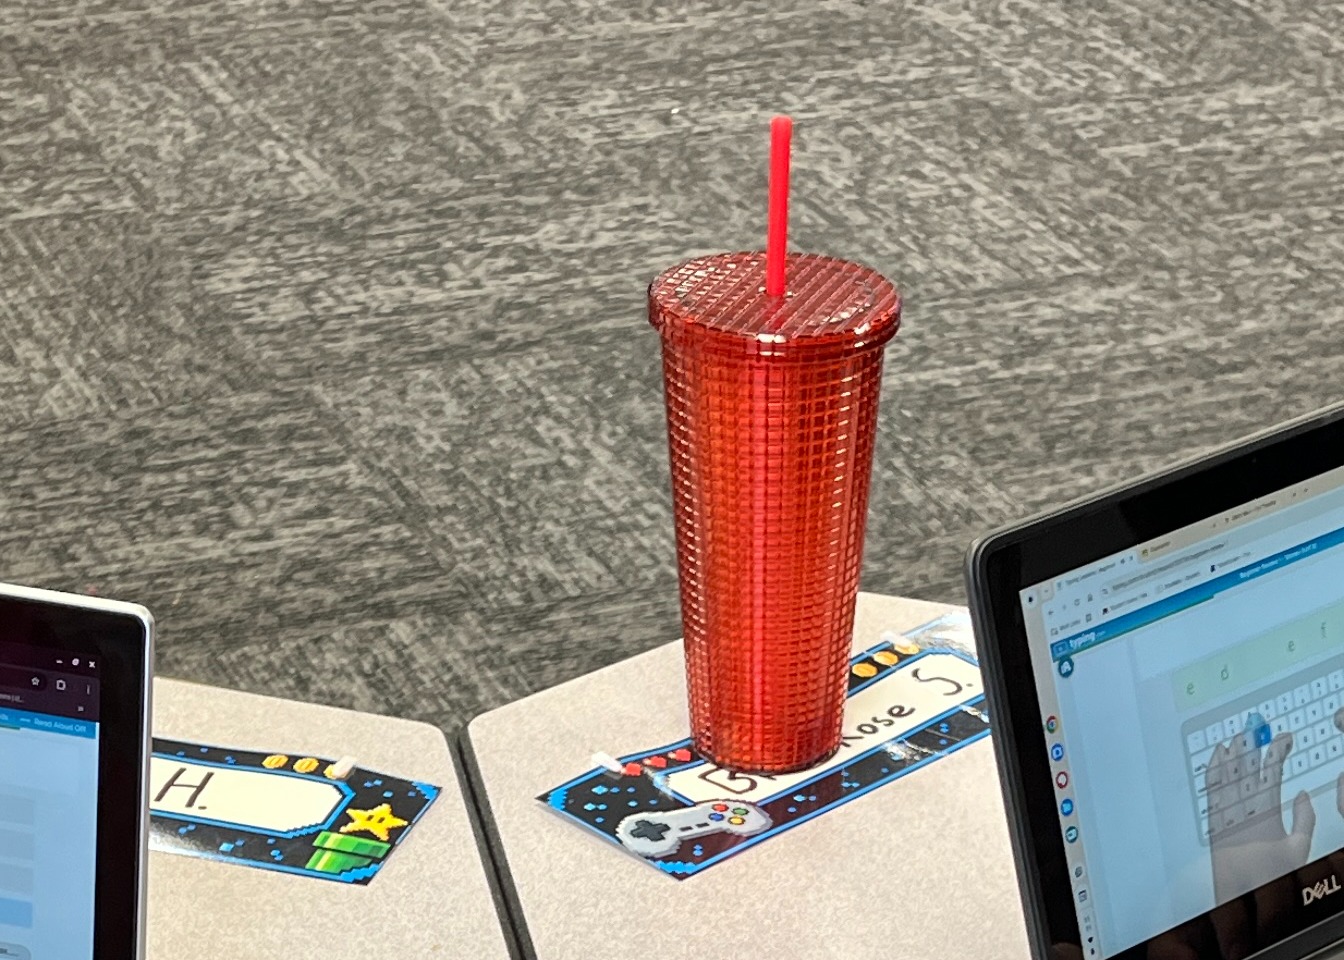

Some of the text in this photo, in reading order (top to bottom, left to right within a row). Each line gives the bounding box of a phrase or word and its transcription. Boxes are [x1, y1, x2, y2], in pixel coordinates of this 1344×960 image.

[1069, 631, 1096, 650] typing
[911, 667, 973, 696] S.
[153, 767, 215, 810] H.
[1302, 874, 1342, 906] DELL
